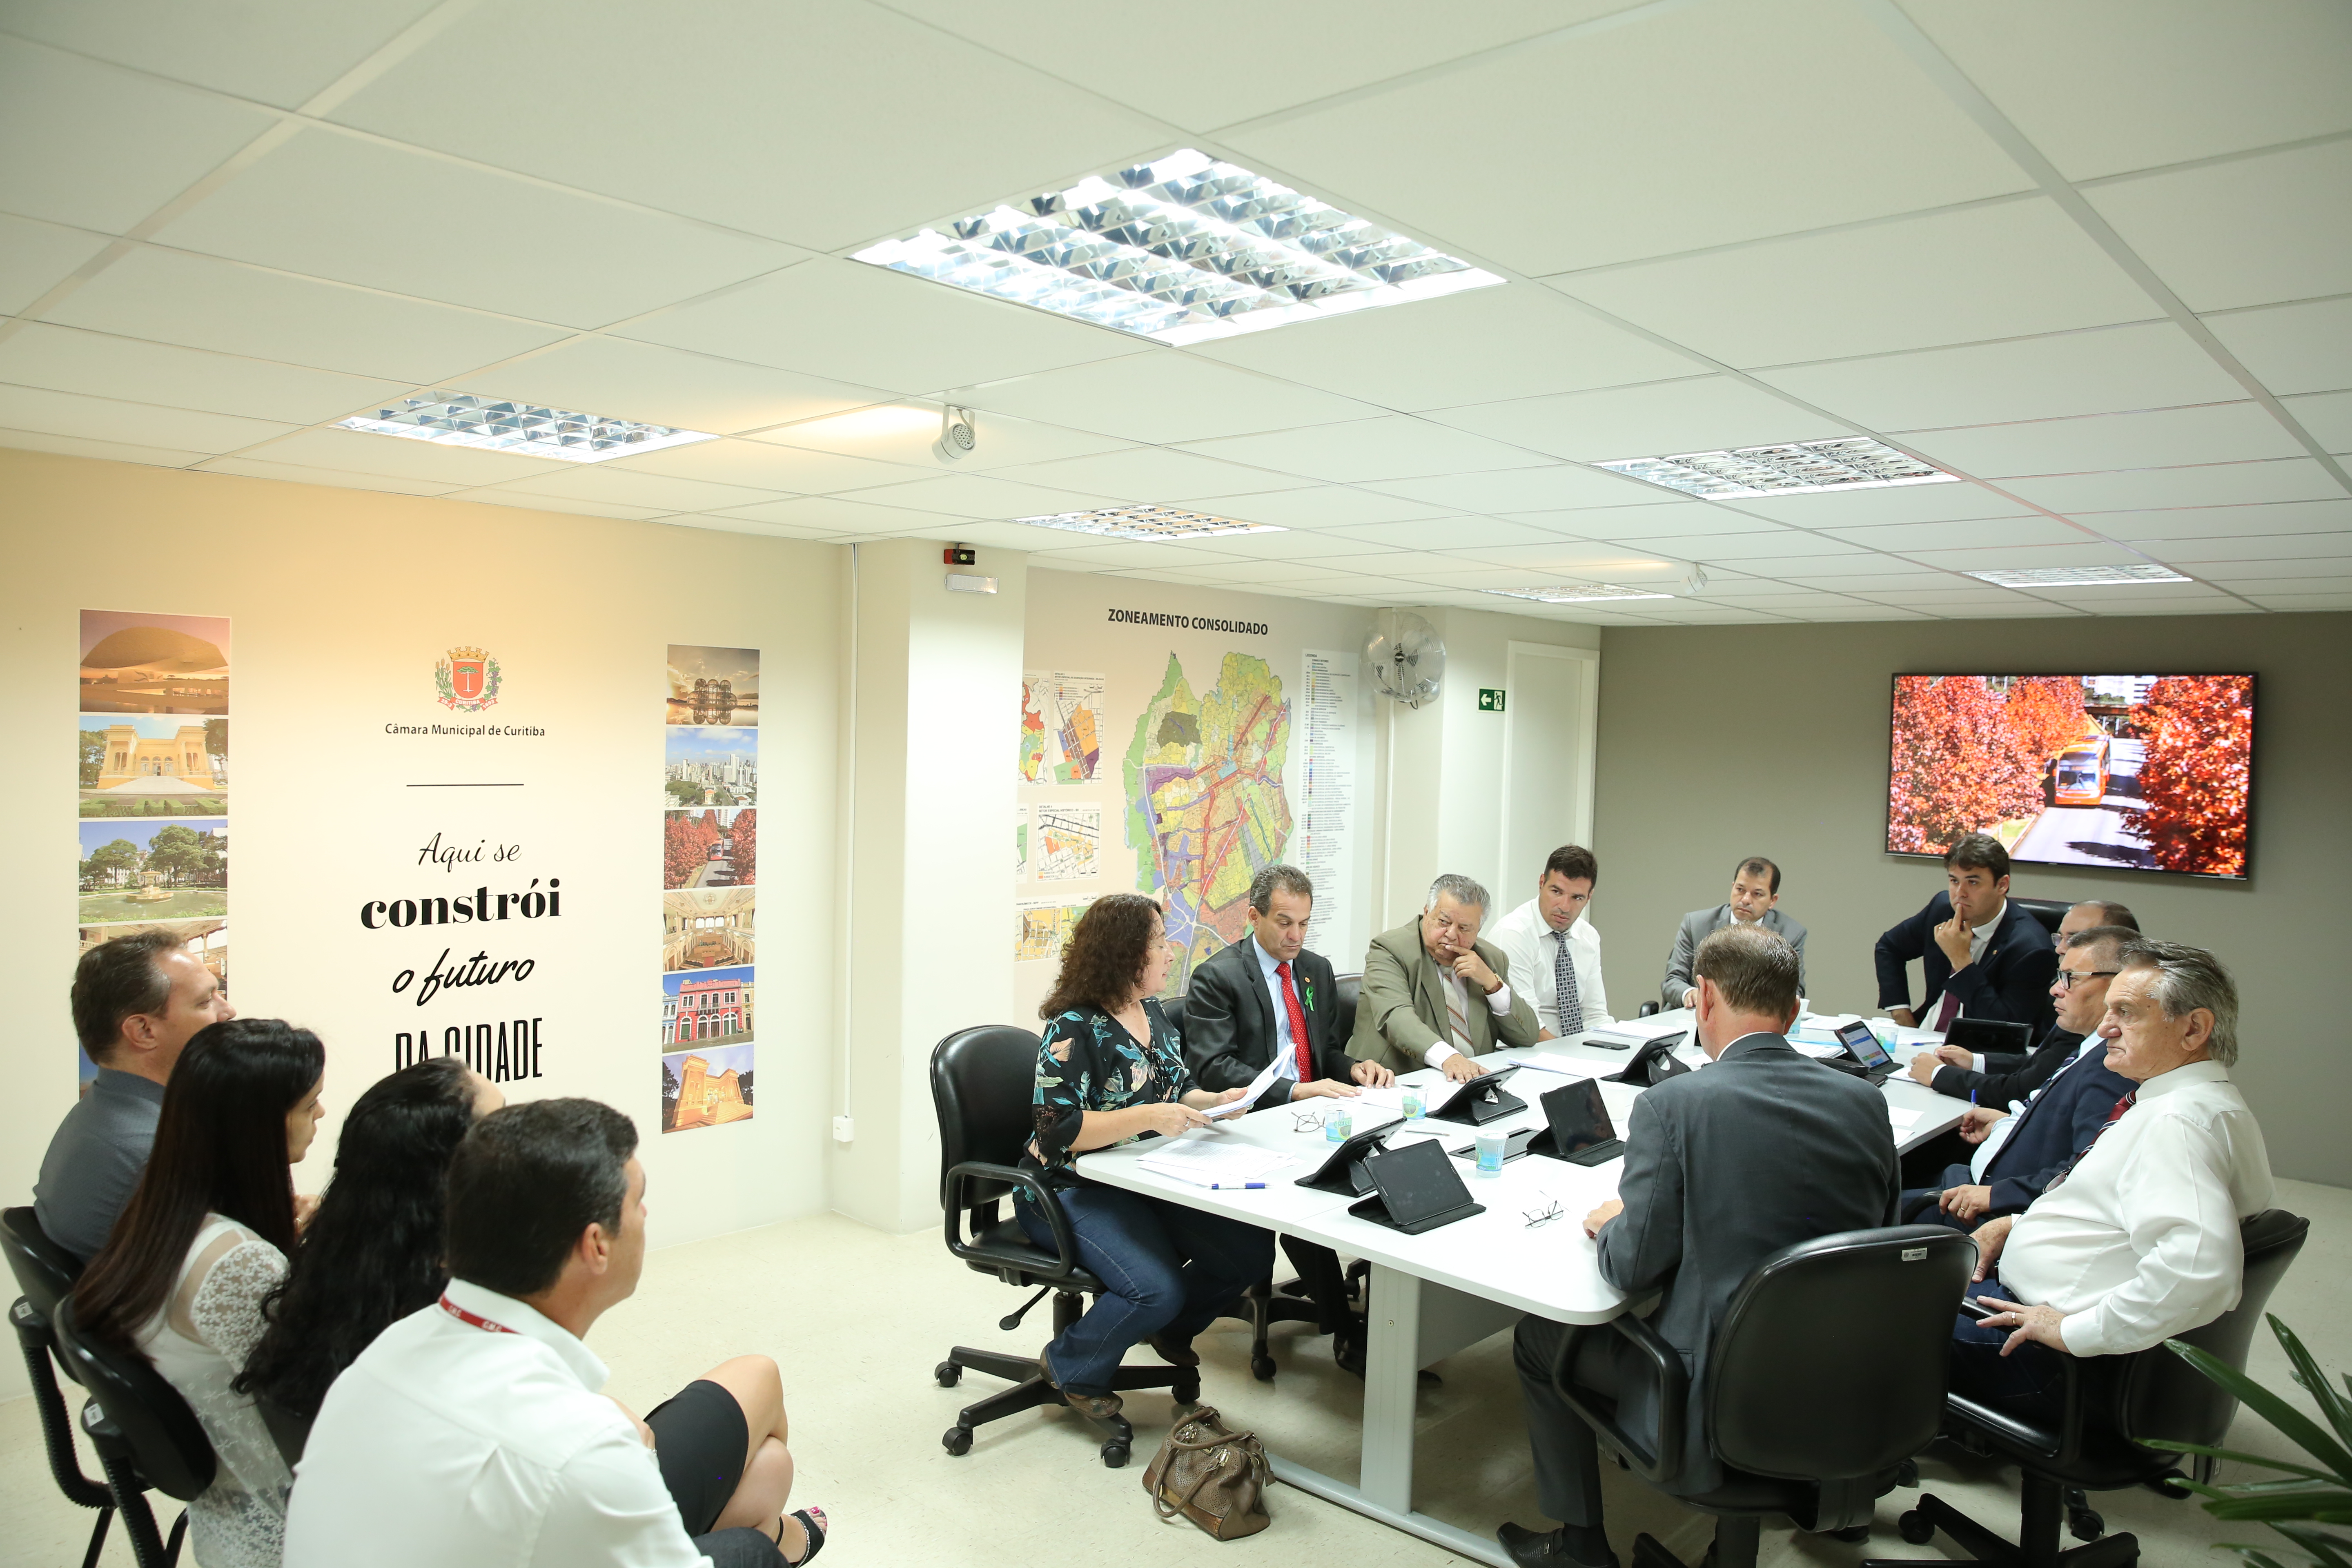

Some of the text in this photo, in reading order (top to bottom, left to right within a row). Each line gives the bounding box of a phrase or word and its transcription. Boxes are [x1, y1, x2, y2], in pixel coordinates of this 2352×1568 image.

[1108, 609, 1268, 635] ZONEAMENTO CONSOLIDADO
[483, 699, 495, 708] 1693
[385, 723, 545, 737] Câmara Municipal de Curitiba
[418, 832, 522, 873] Aqui se
[361, 878, 561, 929] constrói
[392, 948, 535, 1007] o futuro
